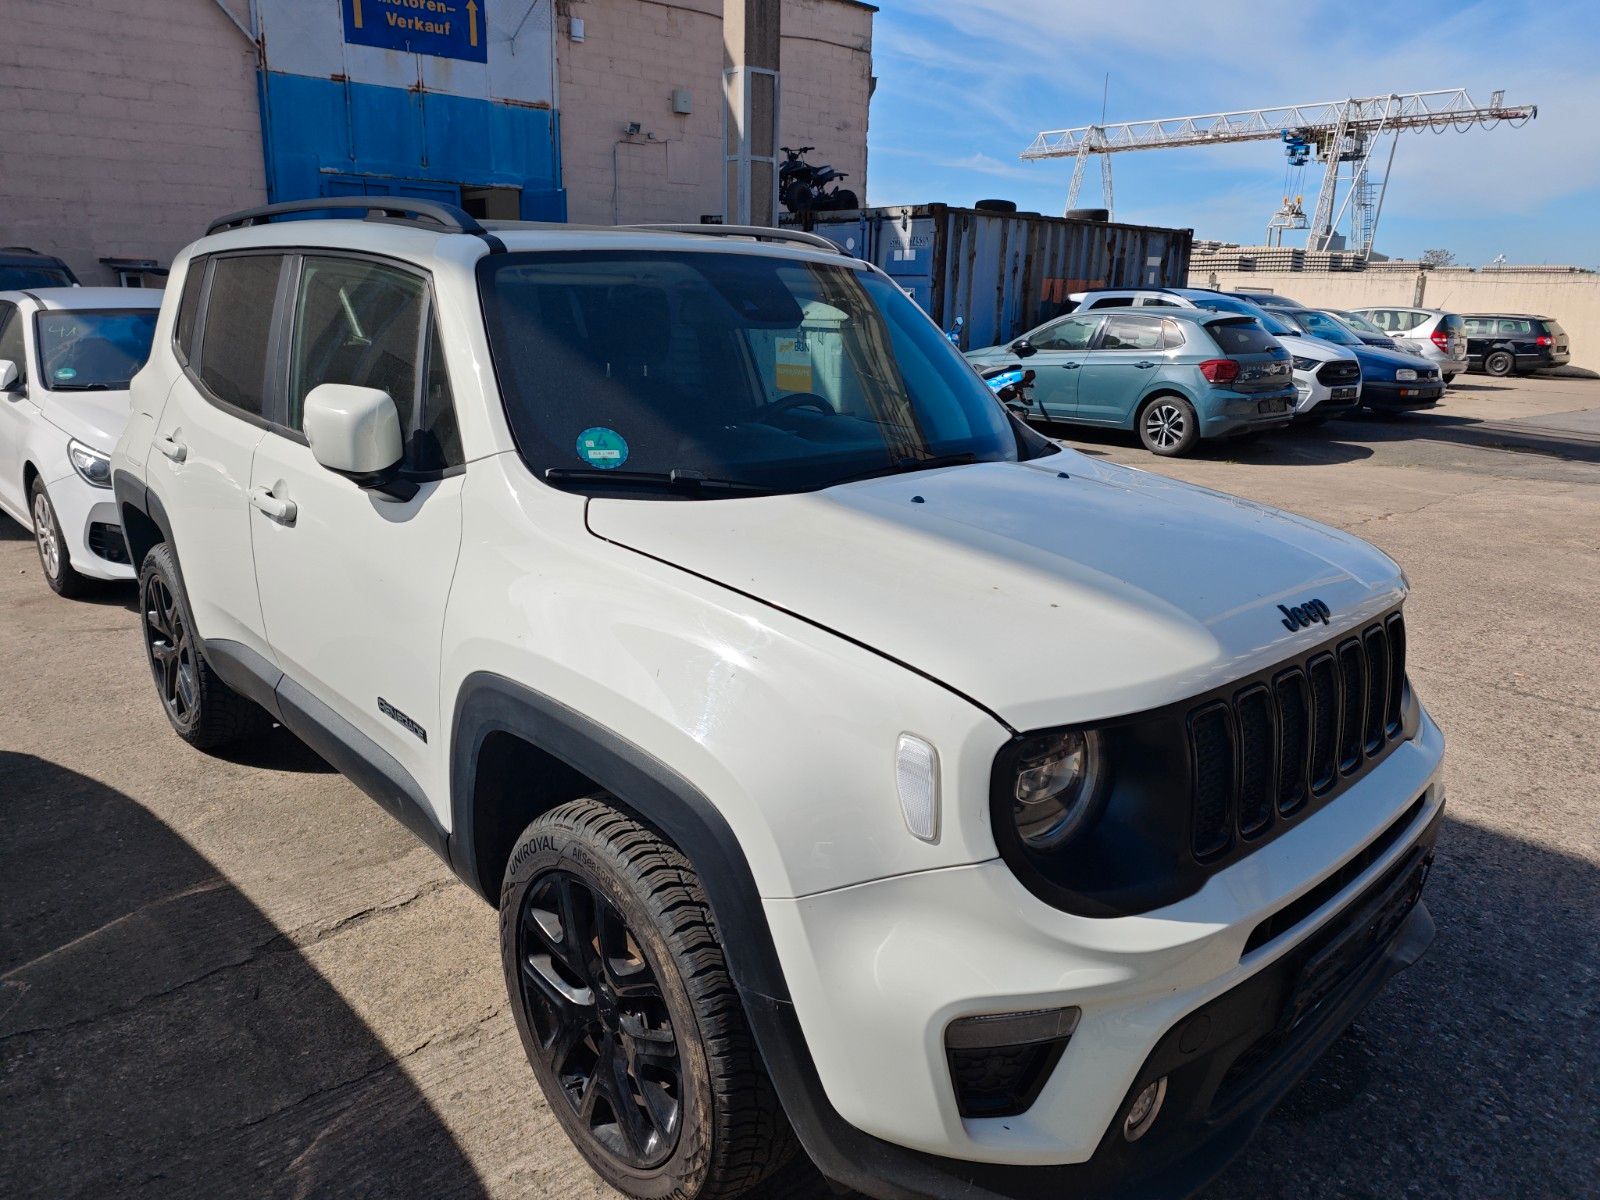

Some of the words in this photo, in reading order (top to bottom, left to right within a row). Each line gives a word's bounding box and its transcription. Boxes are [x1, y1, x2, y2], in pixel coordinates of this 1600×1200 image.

[378, 0, 457, 13] otoren-
[386, 11, 451, 35] Verkauf
[1277, 598, 1331, 633] Jeep
[508, 835, 559, 876] UNIROYAL
